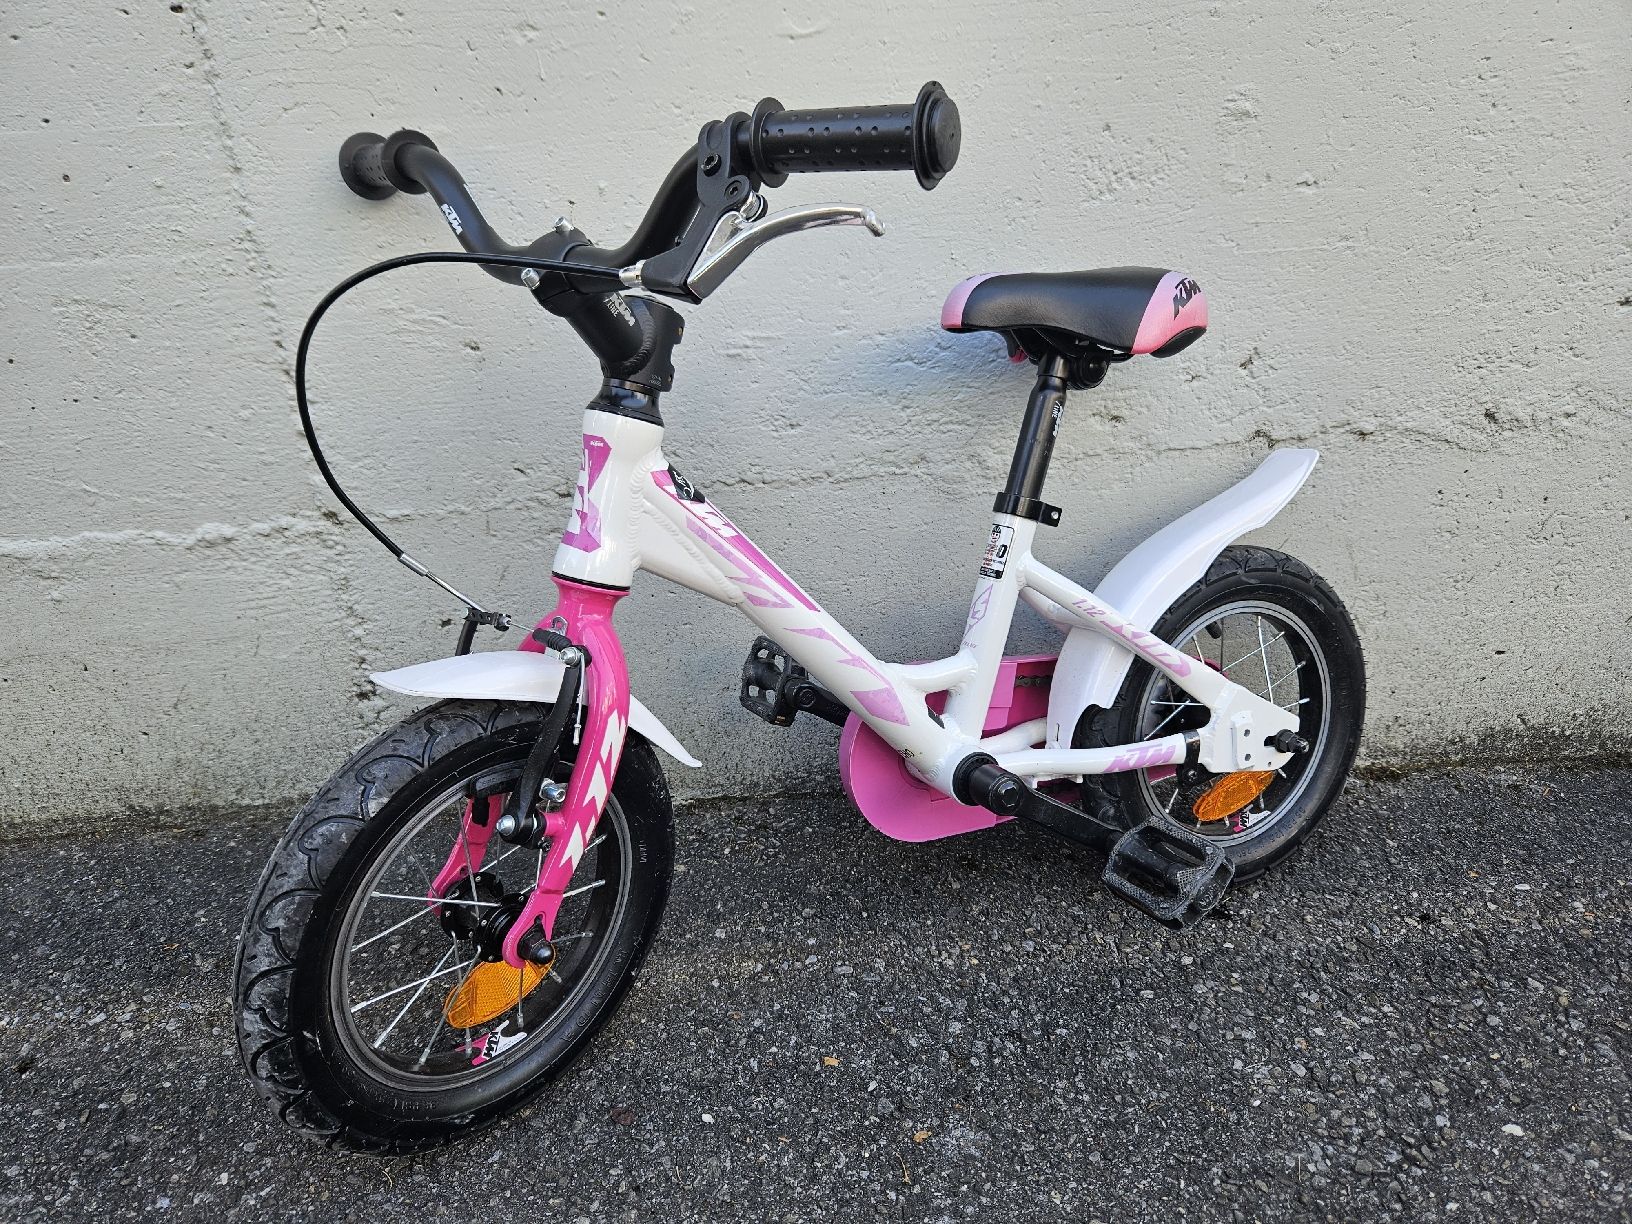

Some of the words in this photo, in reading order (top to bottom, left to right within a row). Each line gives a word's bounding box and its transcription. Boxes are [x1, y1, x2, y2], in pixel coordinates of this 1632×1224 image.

[441, 203, 463, 235] KTM
[610, 292, 636, 327] KTM
[1173, 277, 1202, 320] KTM
[1104, 744, 1177, 772] KTM
[482, 1031, 501, 1059] KTM
